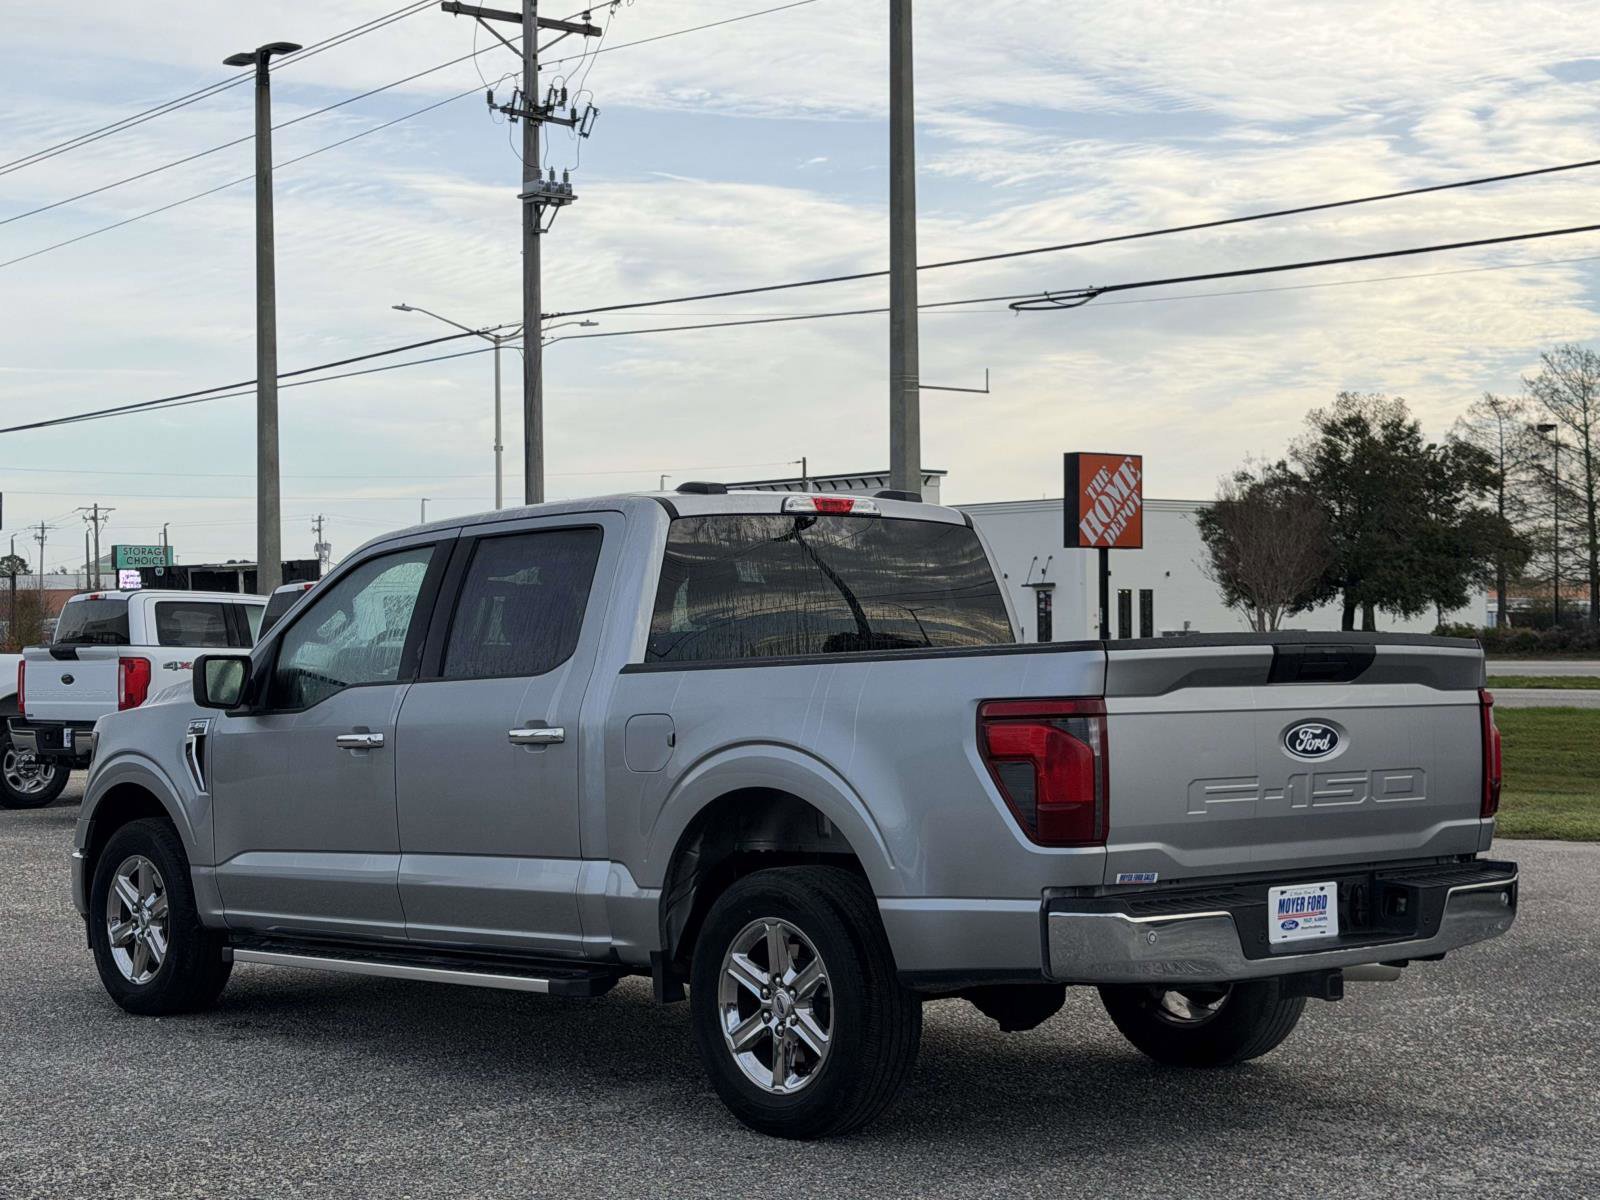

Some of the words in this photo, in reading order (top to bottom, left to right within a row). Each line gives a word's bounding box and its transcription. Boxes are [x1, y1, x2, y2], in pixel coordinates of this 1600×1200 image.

[1085, 465, 1111, 500] THE
[1079, 458, 1141, 545] HOME
[1103, 490, 1141, 545] DEPOT
[126, 556, 165, 565] CHOICE
[1295, 727, 1331, 751] Ford
[1187, 766, 1427, 814] F-150
[1279, 897, 1305, 914] MOYER
[1306, 895, 1327, 911] FORD
